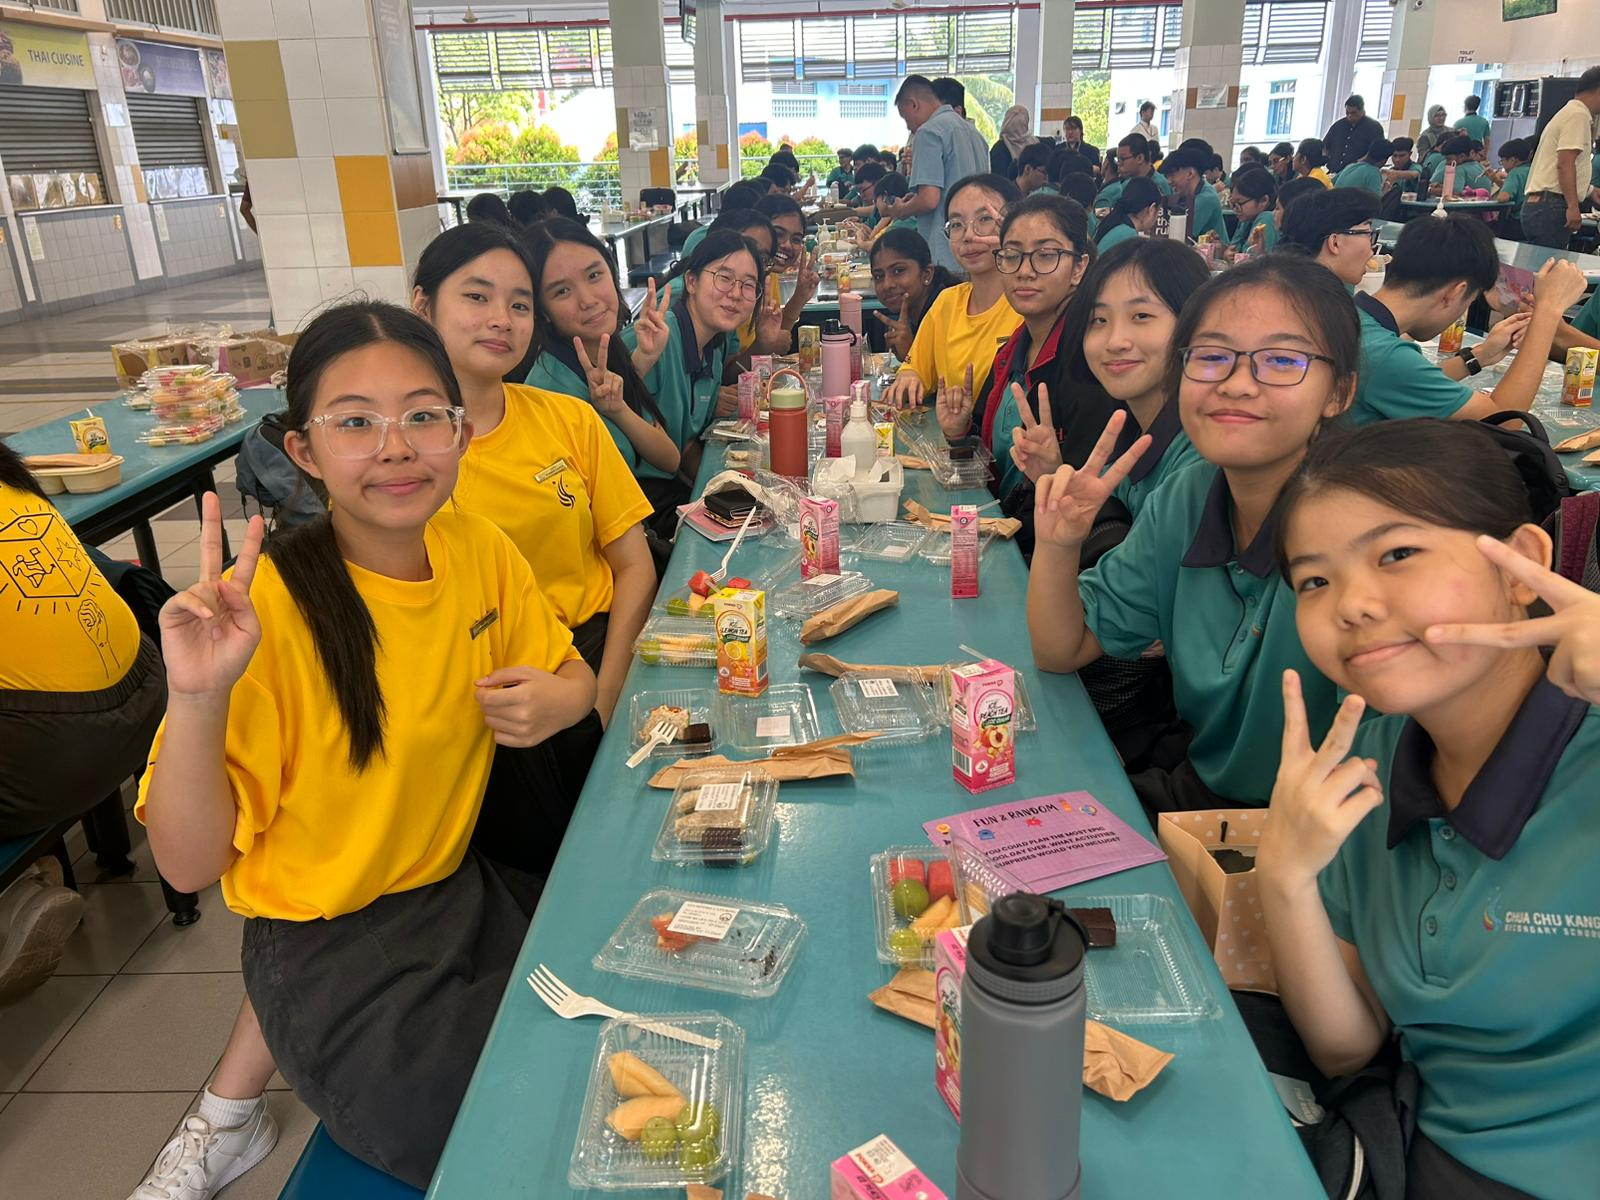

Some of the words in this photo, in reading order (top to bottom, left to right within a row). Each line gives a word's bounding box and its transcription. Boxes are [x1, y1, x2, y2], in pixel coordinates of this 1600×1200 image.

[27, 49, 50, 63] THAI
[51, 51, 84, 67] CUISINE
[980, 708, 999, 720] PEACH
[973, 815, 999, 828] FUN
[1007, 803, 1060, 820] RANDOM
[1001, 841, 1029, 851] COULD
[1028, 837, 1050, 845] PLAN
[1064, 828, 1087, 837] MOST
[1009, 848, 1026, 857] DAY
[1049, 838, 1073, 847] WHAT
[1075, 831, 1116, 842] ACTIVITIES
[1036, 846, 1067, 857] WOULD
[1066, 842, 1085, 851] YOU
[1505, 911, 1530, 924] CHUA
[1532, 912, 1562, 926] CHU
[1564, 914, 1600, 929] KANG
[1505, 924, 1557, 934] SECONDARY
